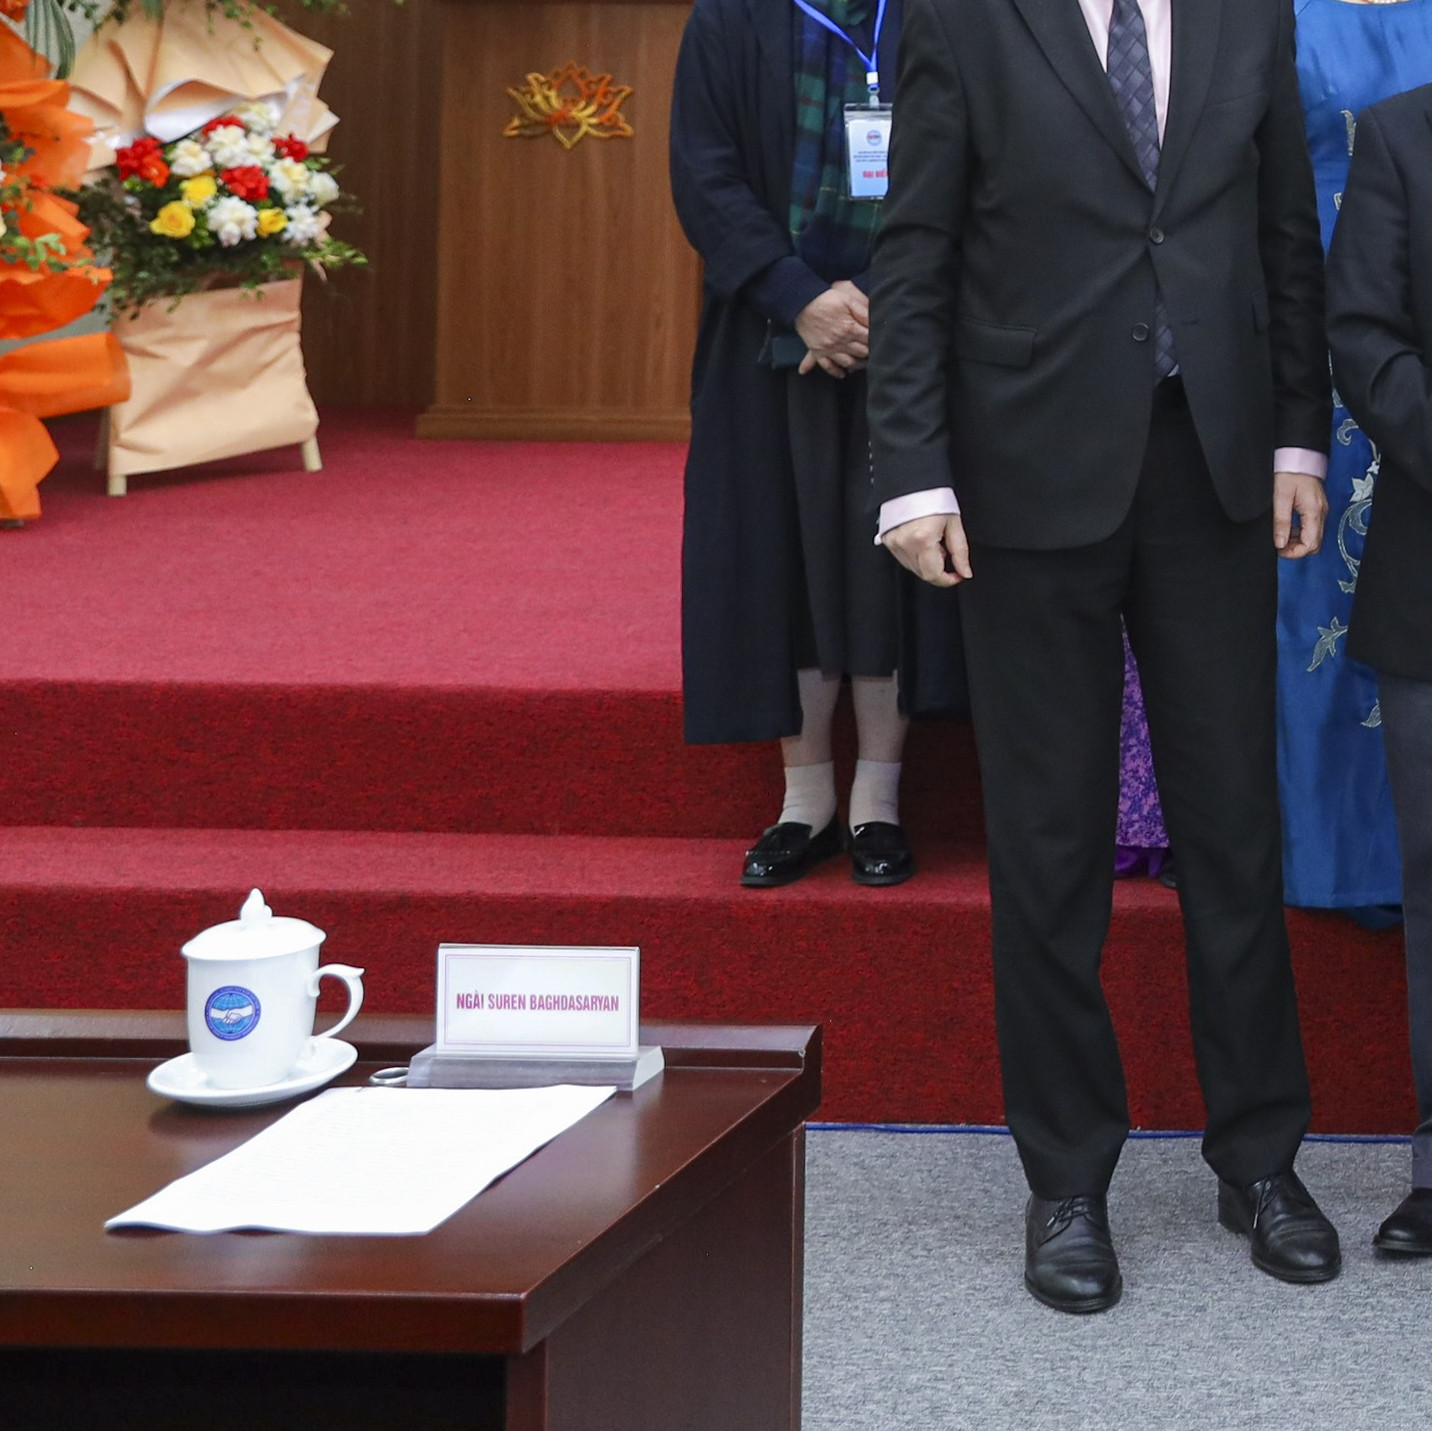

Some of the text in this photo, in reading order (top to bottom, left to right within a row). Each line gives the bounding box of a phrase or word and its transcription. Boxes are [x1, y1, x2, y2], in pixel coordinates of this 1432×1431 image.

[456, 989, 619, 1012] NGÀI SUREN BAGHDASARYAN
